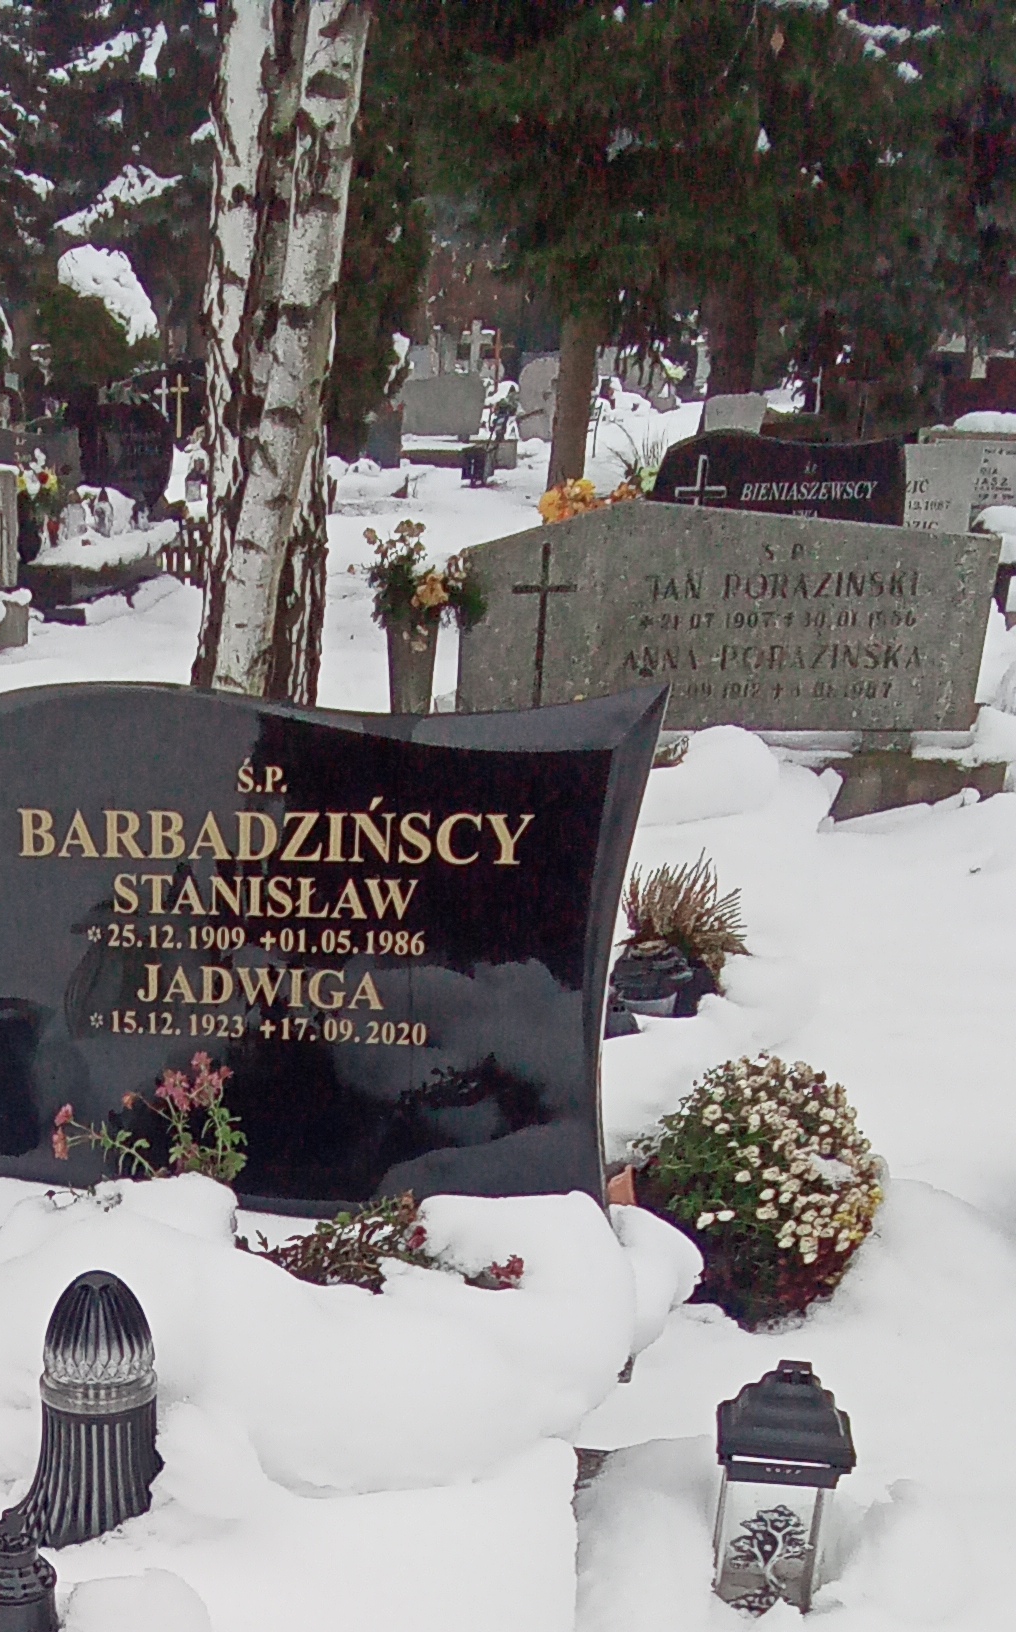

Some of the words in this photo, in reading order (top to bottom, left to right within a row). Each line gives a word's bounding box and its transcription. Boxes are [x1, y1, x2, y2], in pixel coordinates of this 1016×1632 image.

[740, 480, 878, 502] BIENIASZEWSCY
[236, 757, 289, 793] Ś.P.
[17, 796, 536, 866] BARBADZIŃSCY
[113, 872, 420, 921] STANISŁAW
[136, 963, 384, 1011] JADWIGA
